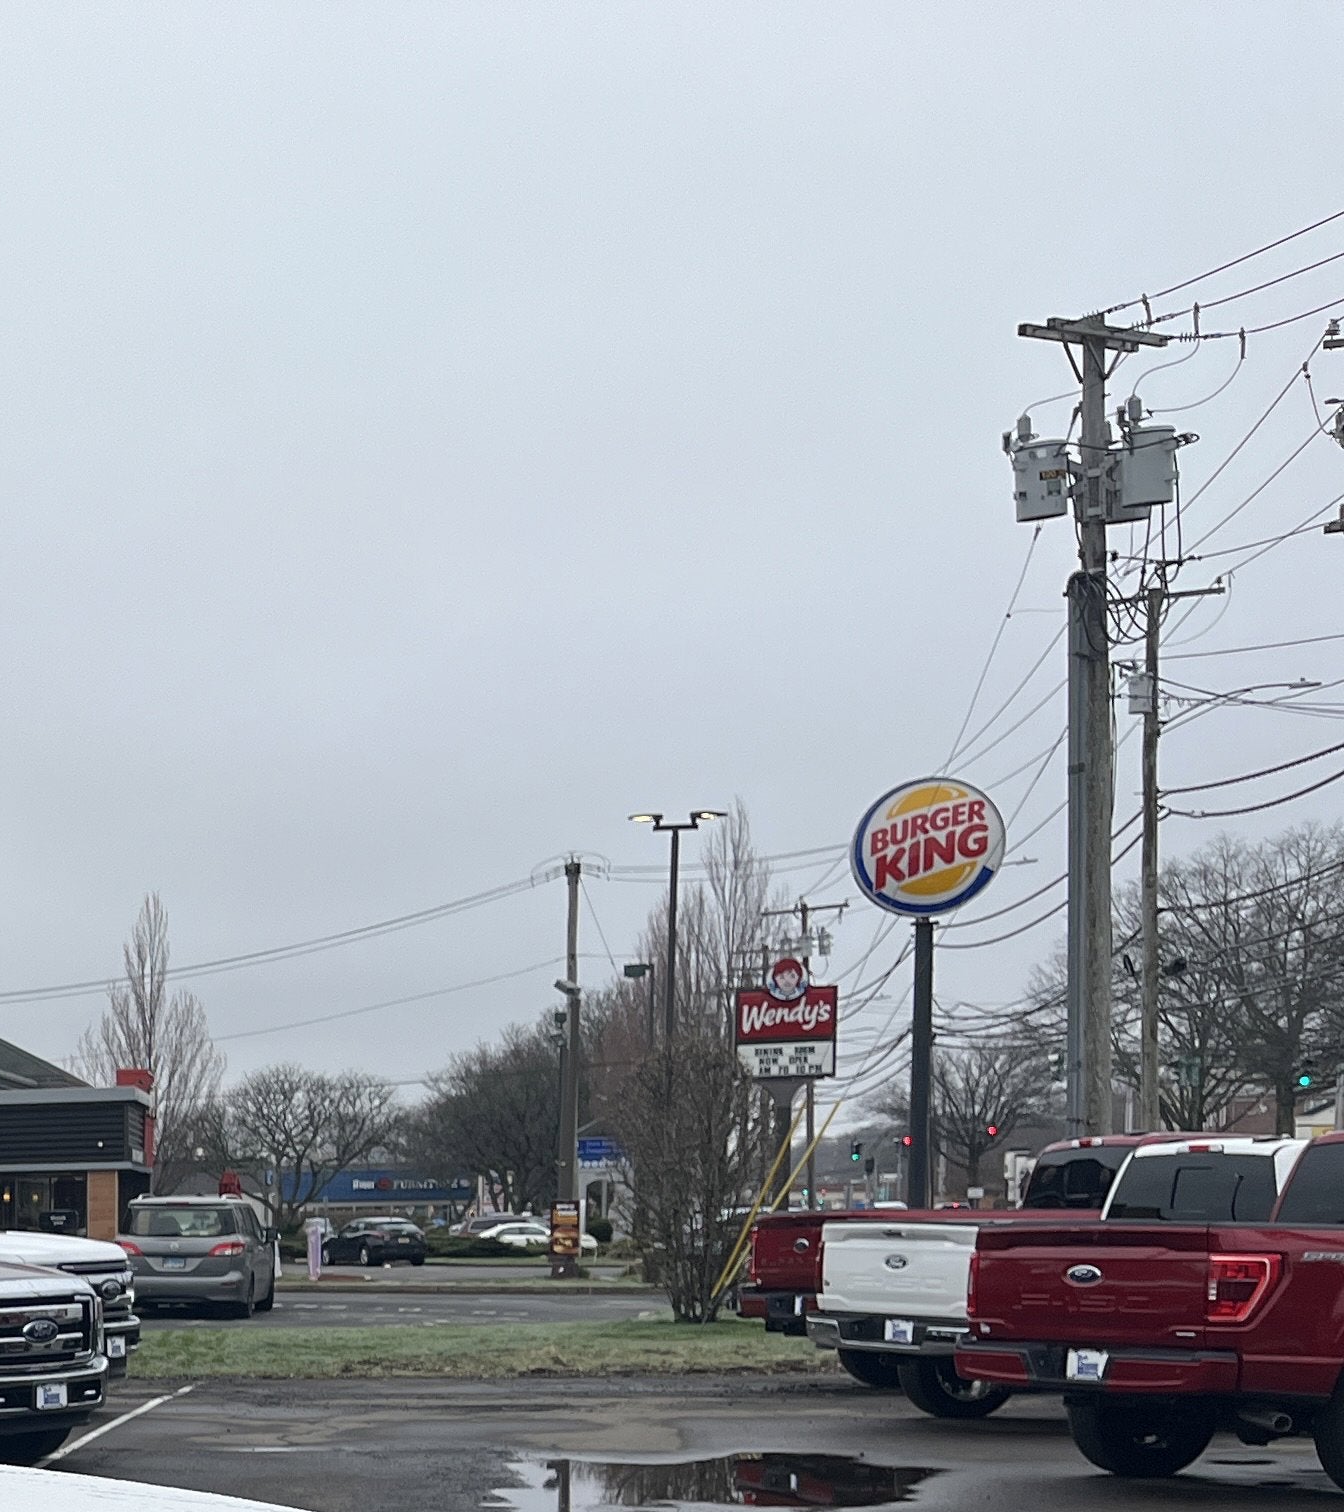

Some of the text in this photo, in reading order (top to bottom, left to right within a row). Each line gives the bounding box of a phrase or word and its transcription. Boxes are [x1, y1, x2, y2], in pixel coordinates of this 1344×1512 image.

[870, 800, 986, 857] BURGER
[874, 823, 989, 891] KING
[741, 995, 832, 1034] Wendy's
[788, 1055, 809, 1064] OPEN
